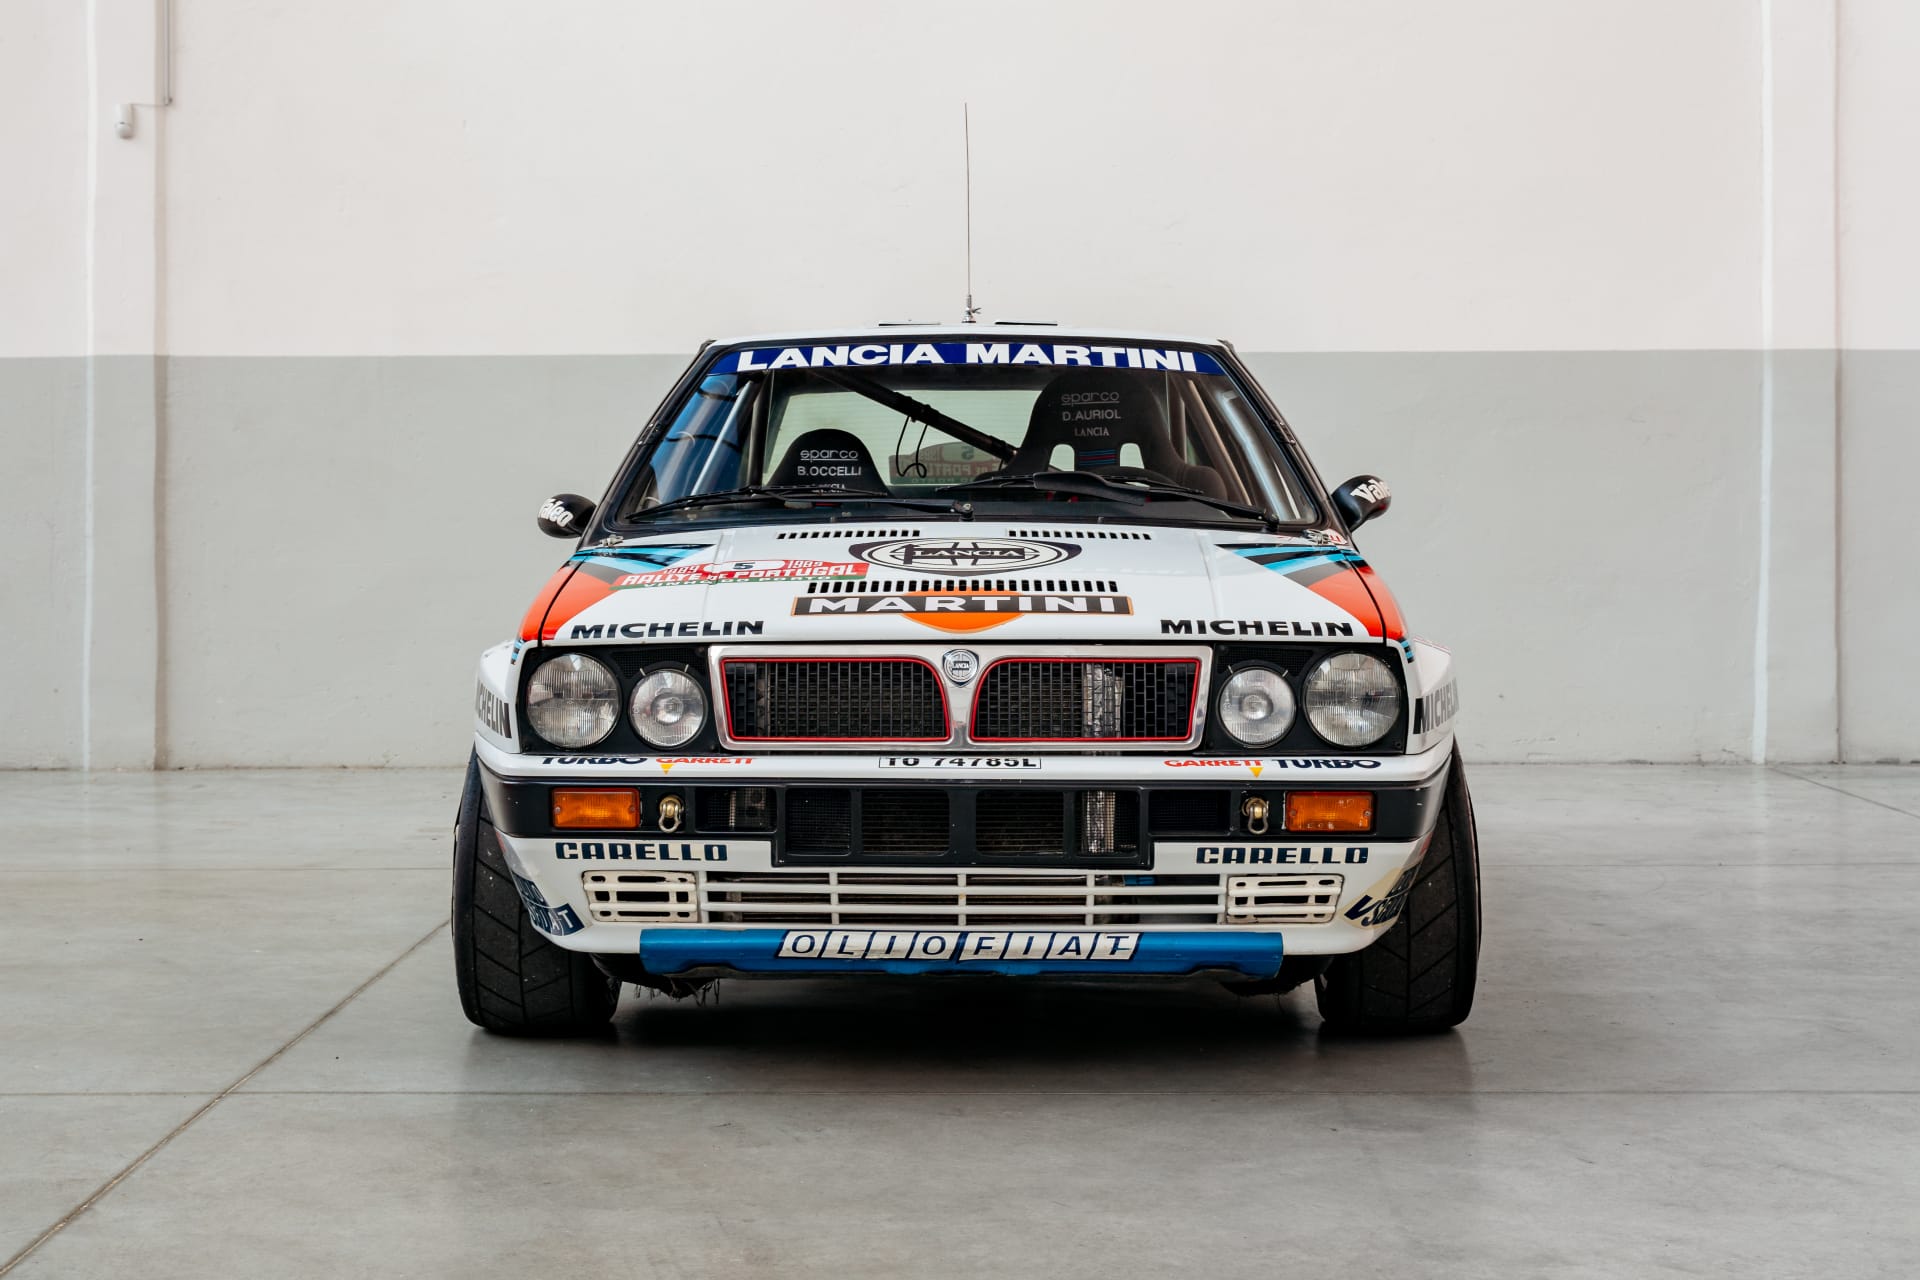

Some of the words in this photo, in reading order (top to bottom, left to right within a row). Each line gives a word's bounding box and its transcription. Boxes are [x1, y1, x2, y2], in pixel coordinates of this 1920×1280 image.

[737, 343, 945, 372] LANCIA
[966, 343, 1197, 372] MARTINI
[1061, 391, 1120, 407] sparco
[1074, 427, 1110, 437] LANCIA
[800, 449, 859, 463] sparco
[797, 466, 862, 476] B.OCCELLI
[914, 549, 1020, 557] LANCIA
[788, 560, 823, 569] 1989
[621, 573, 702, 586] RALLYE
[733, 564, 857, 578] PORTUGAL
[808, 597, 1116, 613] MARTINI
[570, 620, 764, 639] MICHELIN
[1160, 619, 1354, 637] MICHELIN
[542, 757, 649, 765] TURBO
[886, 757, 920, 767] TO
[1164, 759, 1264, 767] GARRETT
[1272, 759, 1381, 769] TURBO
[555, 842, 728, 861] CARELLO
[1196, 847, 1369, 864] CARELLO
[791, 934, 947, 956] OLIO
[973, 935, 1130, 956] FIAT
